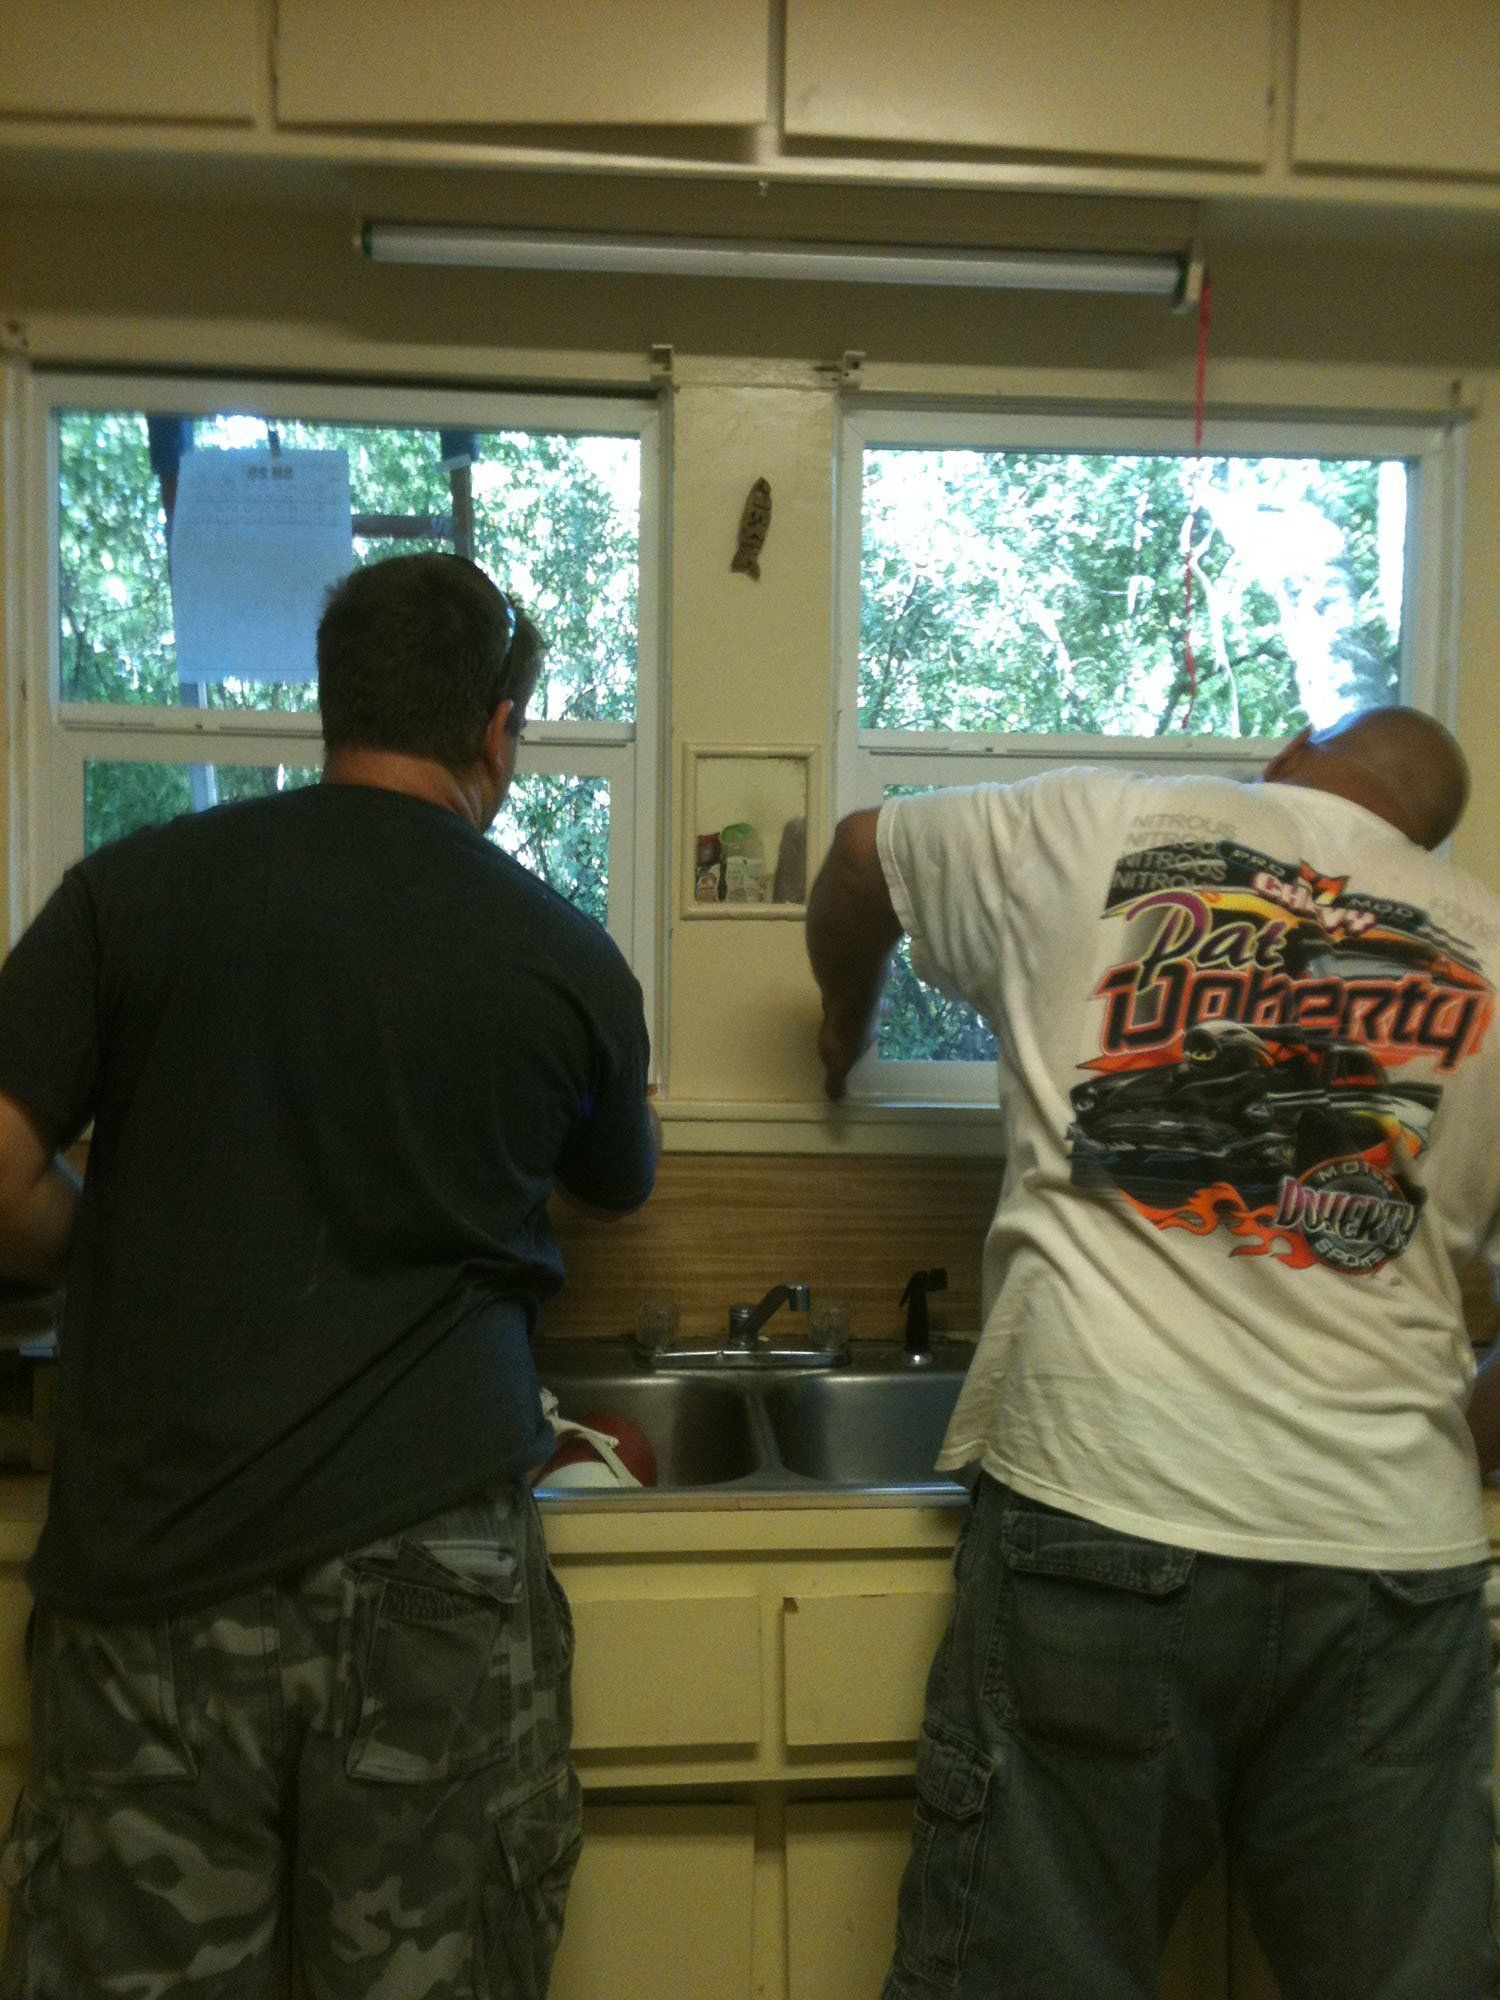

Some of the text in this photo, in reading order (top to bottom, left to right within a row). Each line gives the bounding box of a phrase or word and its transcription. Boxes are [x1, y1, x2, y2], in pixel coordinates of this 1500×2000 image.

[1115, 850, 1228, 882] NITROUS
[1231, 849, 1286, 878] PRO
[1352, 898, 1413, 919] MOD
[1126, 889, 1287, 996] Pat
